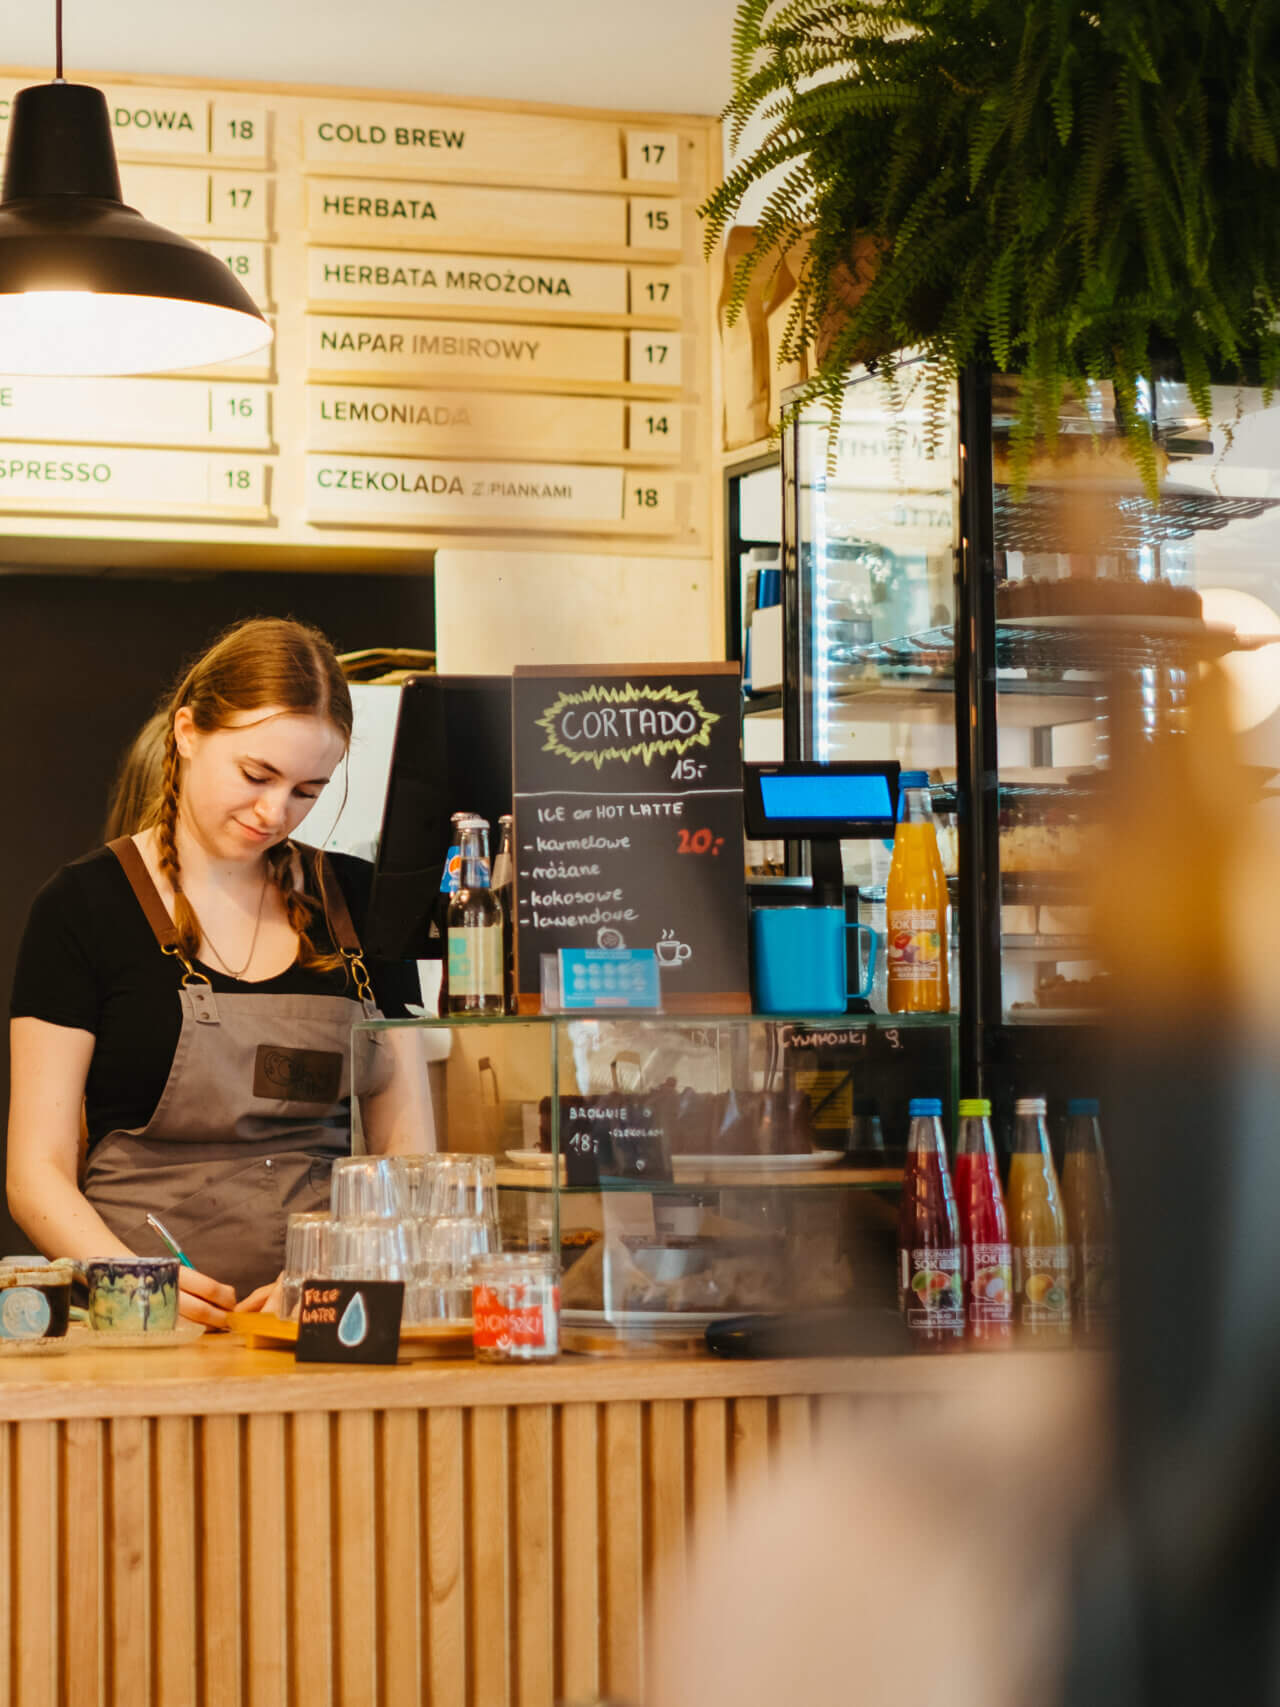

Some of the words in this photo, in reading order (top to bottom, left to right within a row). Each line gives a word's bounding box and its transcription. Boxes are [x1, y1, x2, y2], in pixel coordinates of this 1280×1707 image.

[228, 120, 254, 139] 18
[318, 122, 387, 145] COLD
[395, 127, 465, 150] BREW
[641, 144, 666, 164] 17
[228, 188, 253, 208] 17
[323, 195, 437, 221] HERBATA
[645, 211, 669, 230] 15
[226, 256, 250, 275] 18
[323, 264, 438, 289] HERBATA
[445, 268, 572, 297] MROŻONA
[645, 283, 670, 302] 17
[321, 330, 404, 354] NAPAR
[412, 334, 541, 362] IMBIROWY
[645, 344, 669, 365] 17
[227, 397, 253, 418] 16
[320, 401, 472, 427] LEMONIADA
[645, 416, 669, 435] 14
[225, 470, 251, 490] 18
[317, 468, 465, 496] CZEKOLADA
[489, 481, 572, 499] PIANKAMI
[634, 488, 659, 507] 18
[561, 708, 697, 740] CORTADO
[537, 805, 566, 824] ICE
[595, 805, 625, 819] HOT
[629, 801, 685, 816] LATTE
[530, 888, 624, 907] kokosowe
[569, 1106, 628, 1121] BROWNIE
